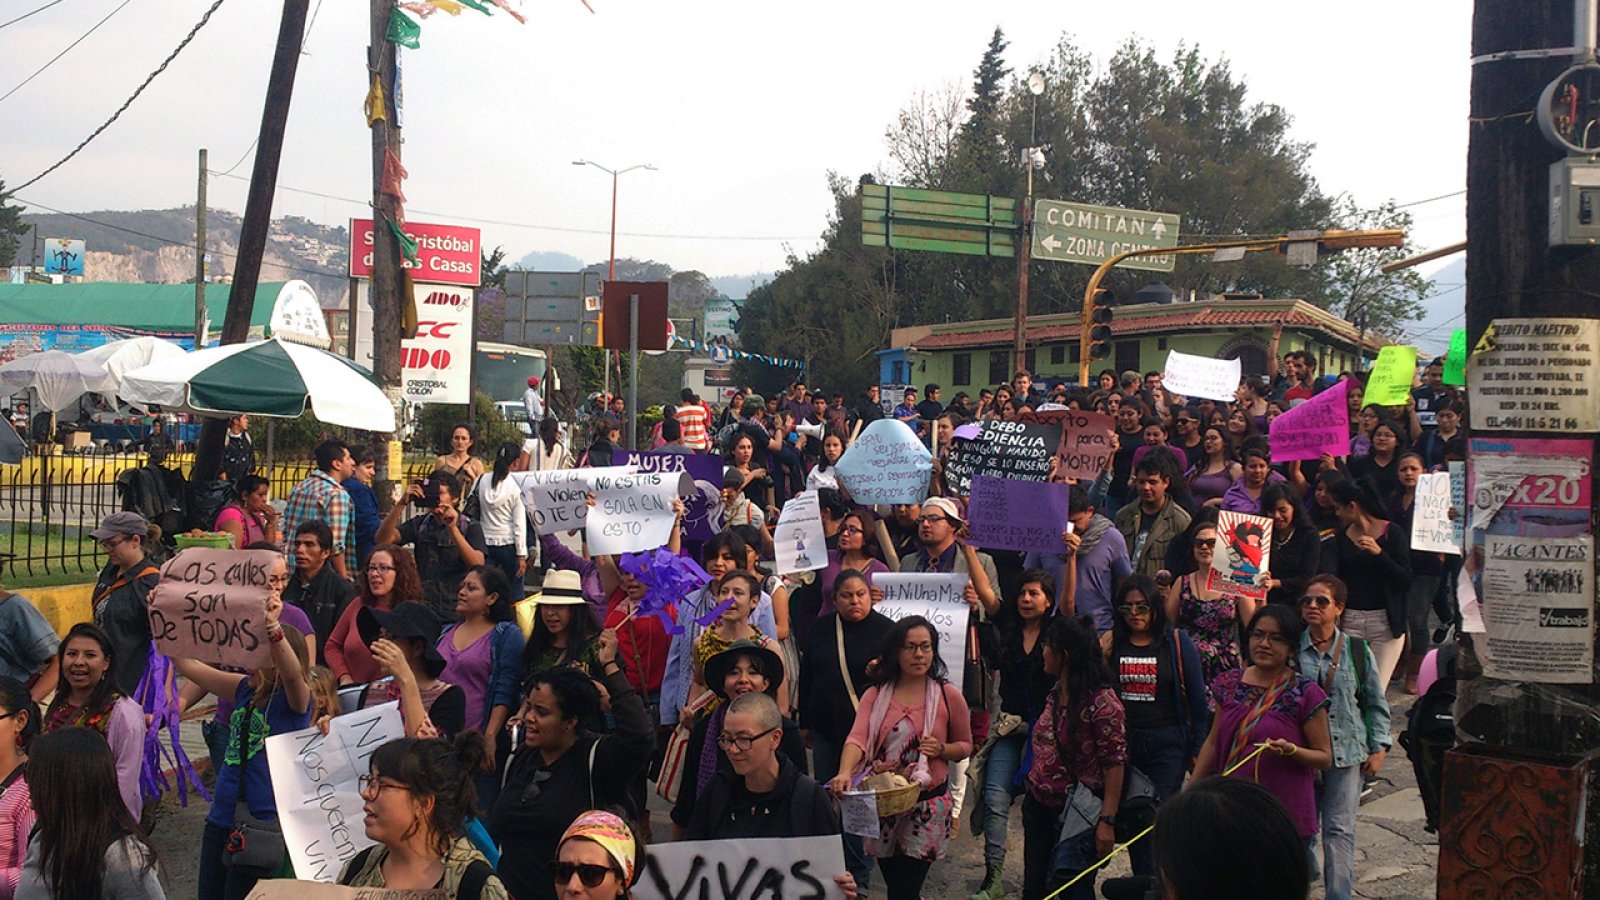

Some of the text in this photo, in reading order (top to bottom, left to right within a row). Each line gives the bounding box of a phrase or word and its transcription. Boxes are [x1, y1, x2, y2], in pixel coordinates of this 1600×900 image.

[1047, 208, 1146, 235] COMITAN
[1066, 237, 1105, 257] ZONA
[429, 256, 473, 274] Casas
[423, 292, 461, 306] ADO
[406, 380, 448, 389] CRISTOBAL
[990, 420, 1026, 433] DEBO
[976, 429, 1045, 447] EDIENCIA
[628, 454, 687, 473] MUJER
[963, 453, 982, 464] ESO
[986, 457, 997, 467] SE
[595, 478, 610, 491] NO
[547, 488, 586, 502] Violen
[603, 499, 638, 516] SOLA
[641, 493, 664, 511] EN
[547, 506, 570, 522] TE
[1493, 543, 1588, 559] VACANTES
[163, 553, 268, 587] Las calles
[184, 590, 227, 613] son
[150, 609, 259, 652] De TODAS
[1120, 664, 1157, 675] LIBRES
[1120, 674, 1157, 684] ESTADOS
[303, 783, 358, 862] querem
